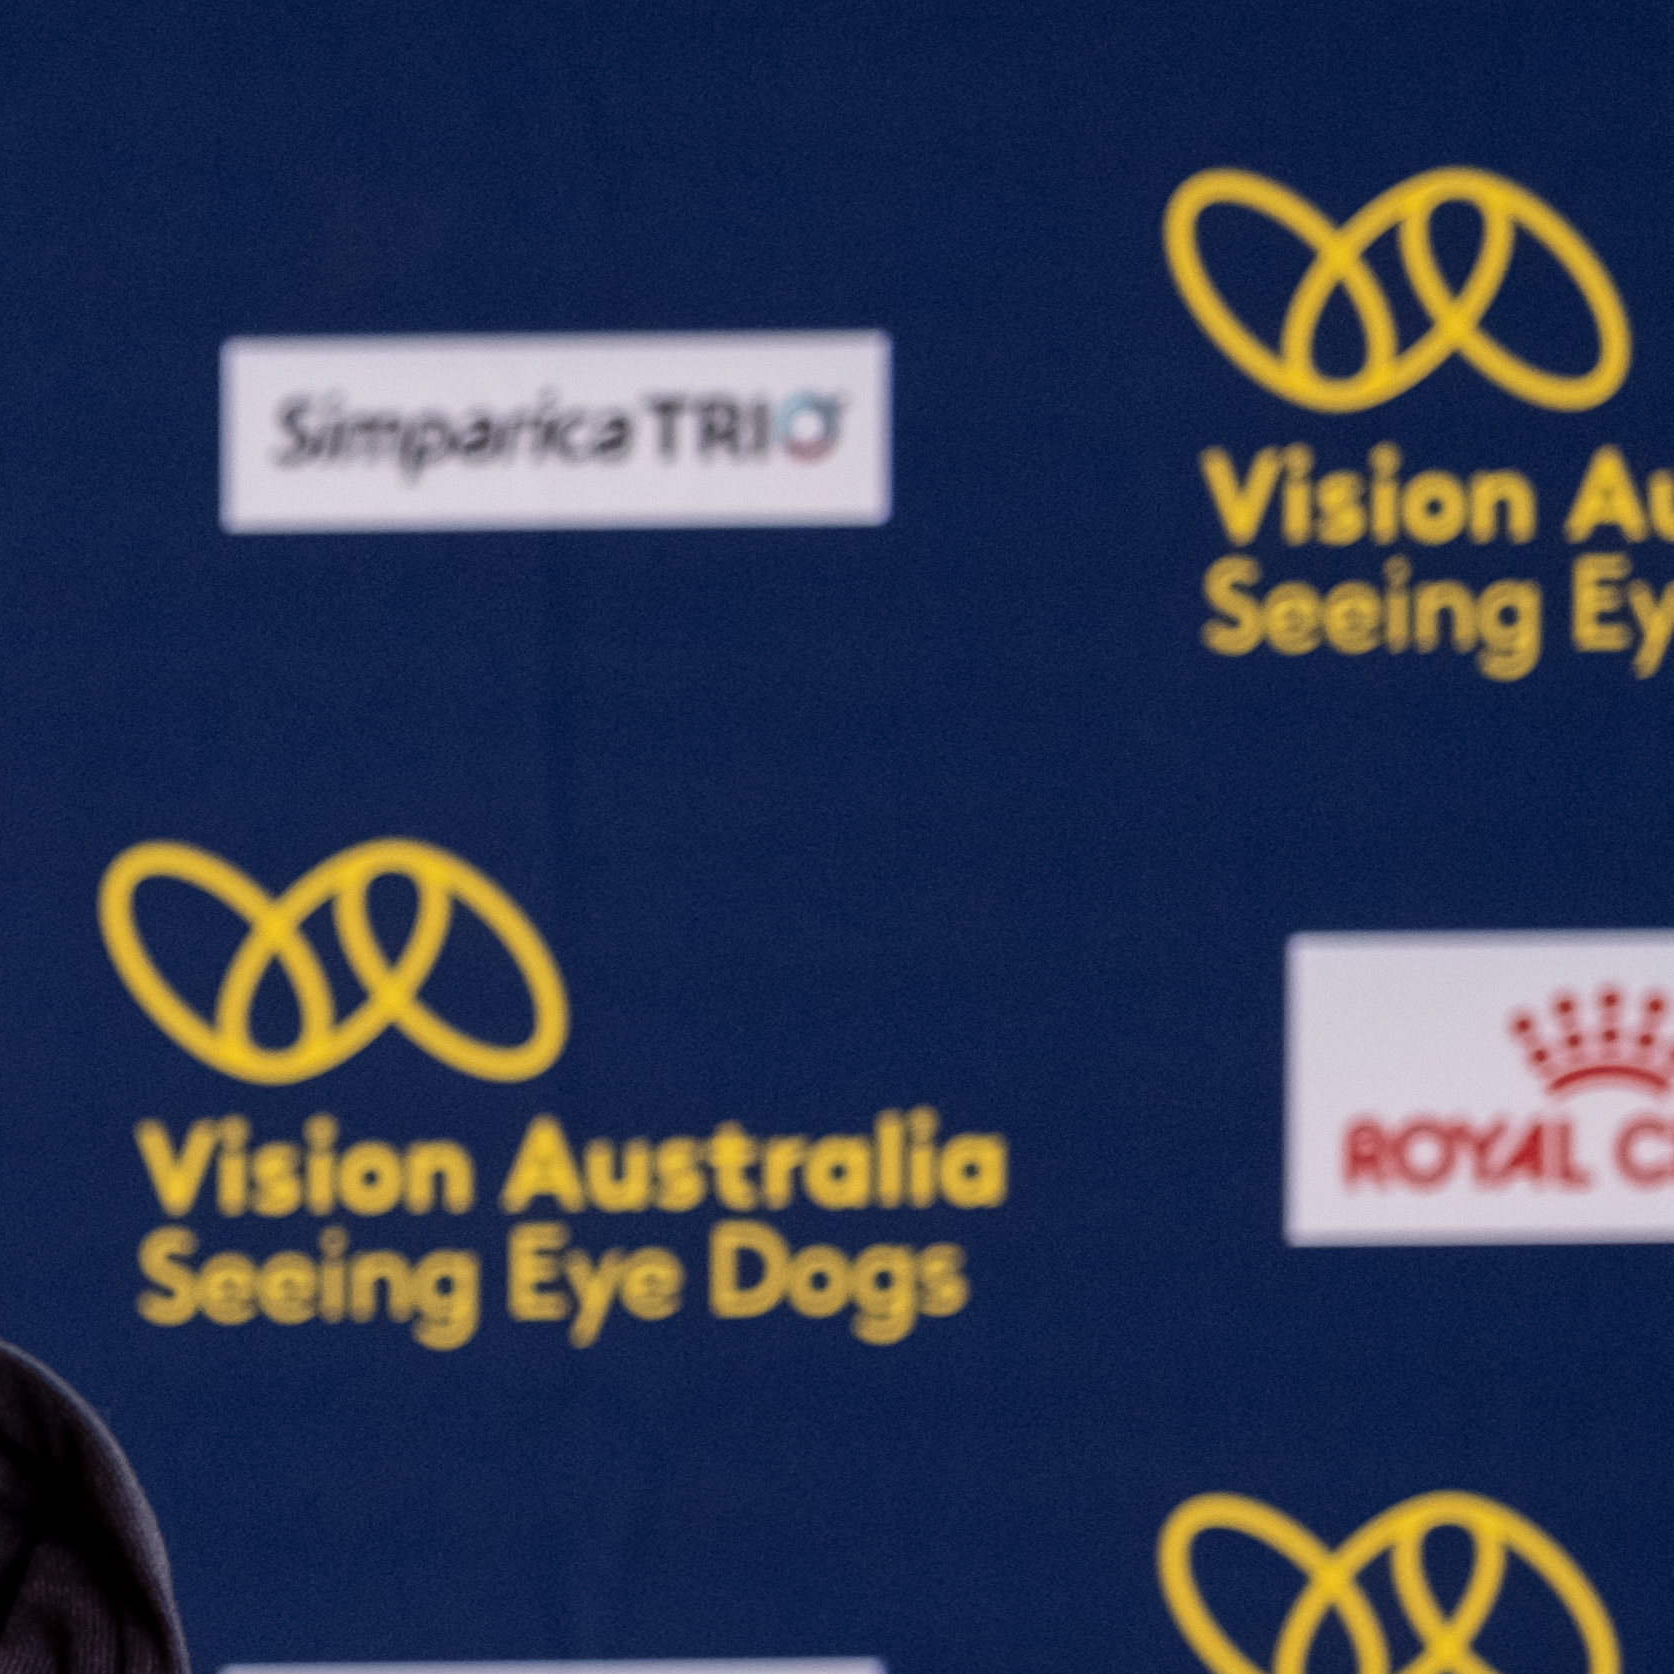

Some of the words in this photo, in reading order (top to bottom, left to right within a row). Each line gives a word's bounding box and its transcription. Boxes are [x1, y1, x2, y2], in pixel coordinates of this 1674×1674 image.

[1202, 444, 1536, 546] Vision
[1204, 554, 1542, 681] Seeing
[136, 1115, 474, 1217] Vision
[502, 1108, 1007, 1213] Australia
[1340, 1116, 1592, 1191] ROYAL
[139, 1226, 480, 1350] Seeing
[507, 1220, 684, 1347] Eye
[709, 1219, 968, 1345] Dogs
